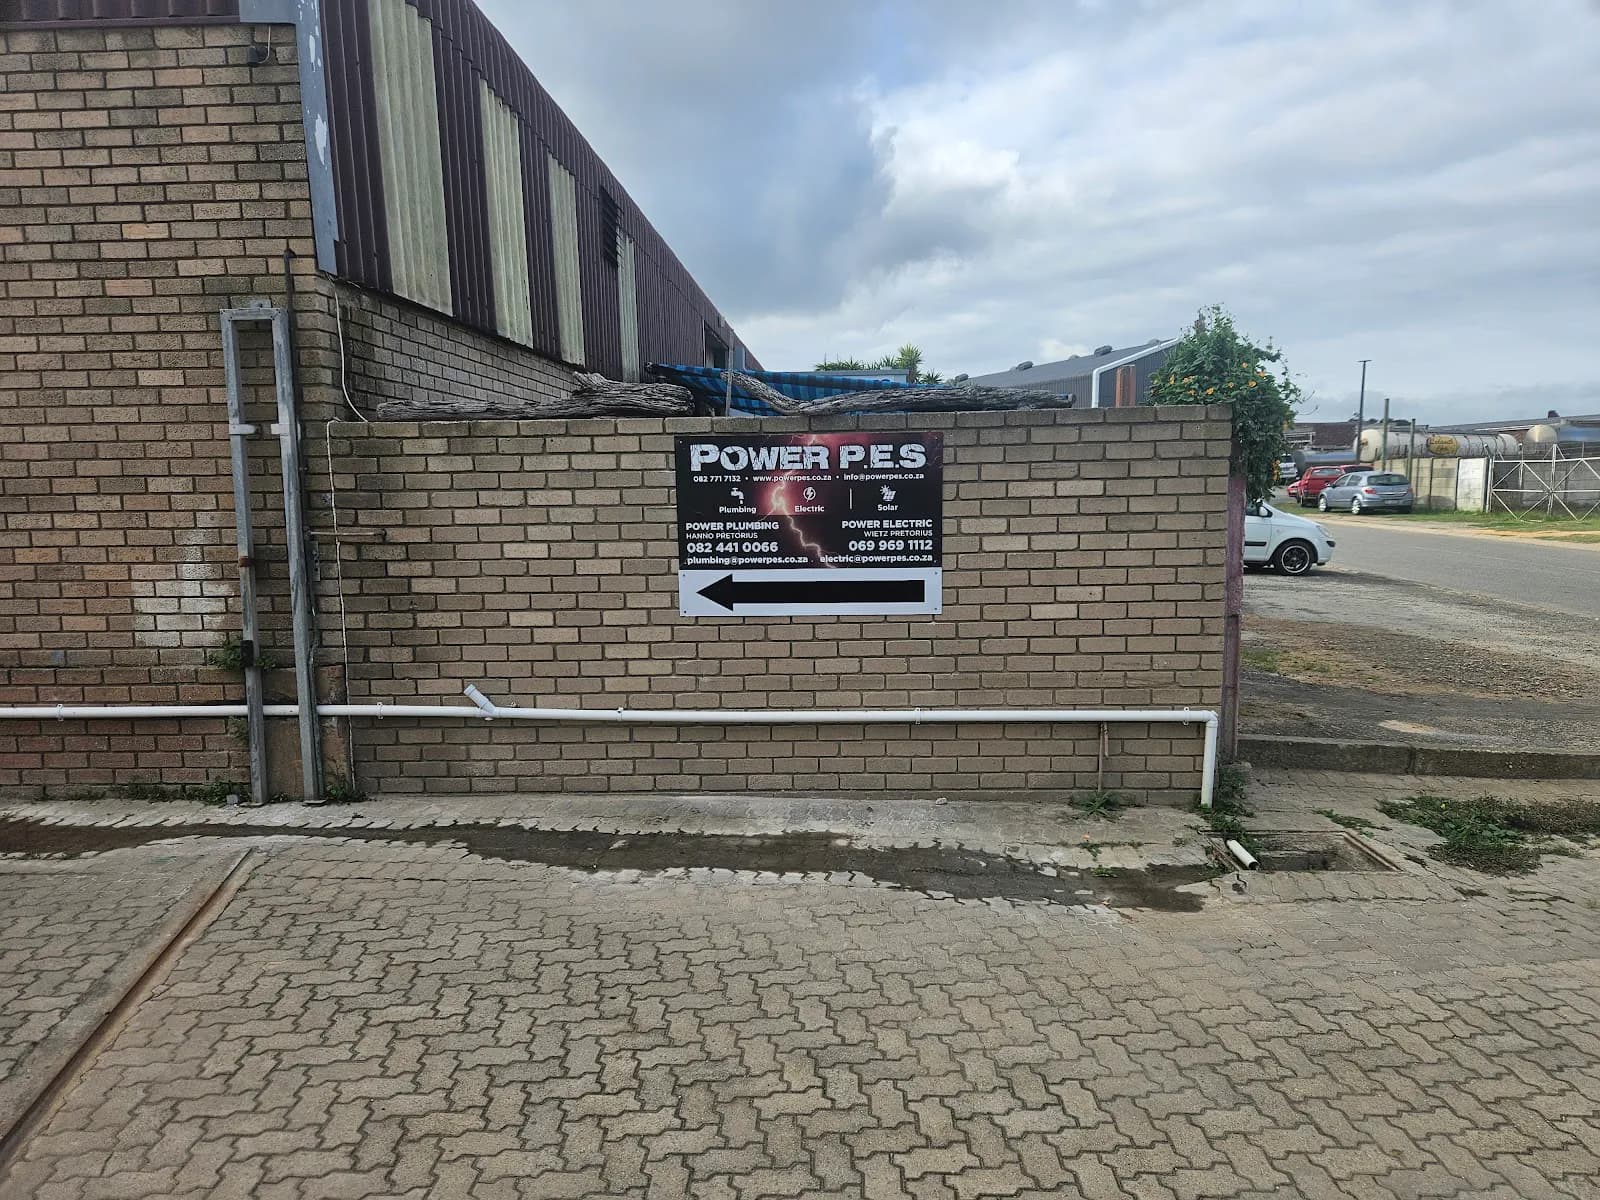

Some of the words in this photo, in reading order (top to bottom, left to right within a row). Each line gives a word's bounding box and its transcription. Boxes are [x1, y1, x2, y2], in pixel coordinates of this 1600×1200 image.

[690, 444, 829, 471] POWER
[840, 443, 926, 469] P.E.S
[844, 473, 925, 481] info@powerpes.co.za
[719, 506, 757, 514] Plumbing
[685, 522, 726, 531] POWER
[726, 521, 780, 530] PLUMBING
[841, 520, 881, 529] POWER
[882, 519, 933, 528] ELECTRIC
[686, 542, 713, 553] 082
[715, 542, 739, 553] 441
[742, 541, 779, 552] 0066
[848, 540, 875, 551] 069
[878, 540, 904, 551] 969
[907, 539, 933, 550] 1112
[687, 556, 809, 565] plumbing@powerpes.co.za
[820, 554, 933, 563] electric@powerpes.co.za
